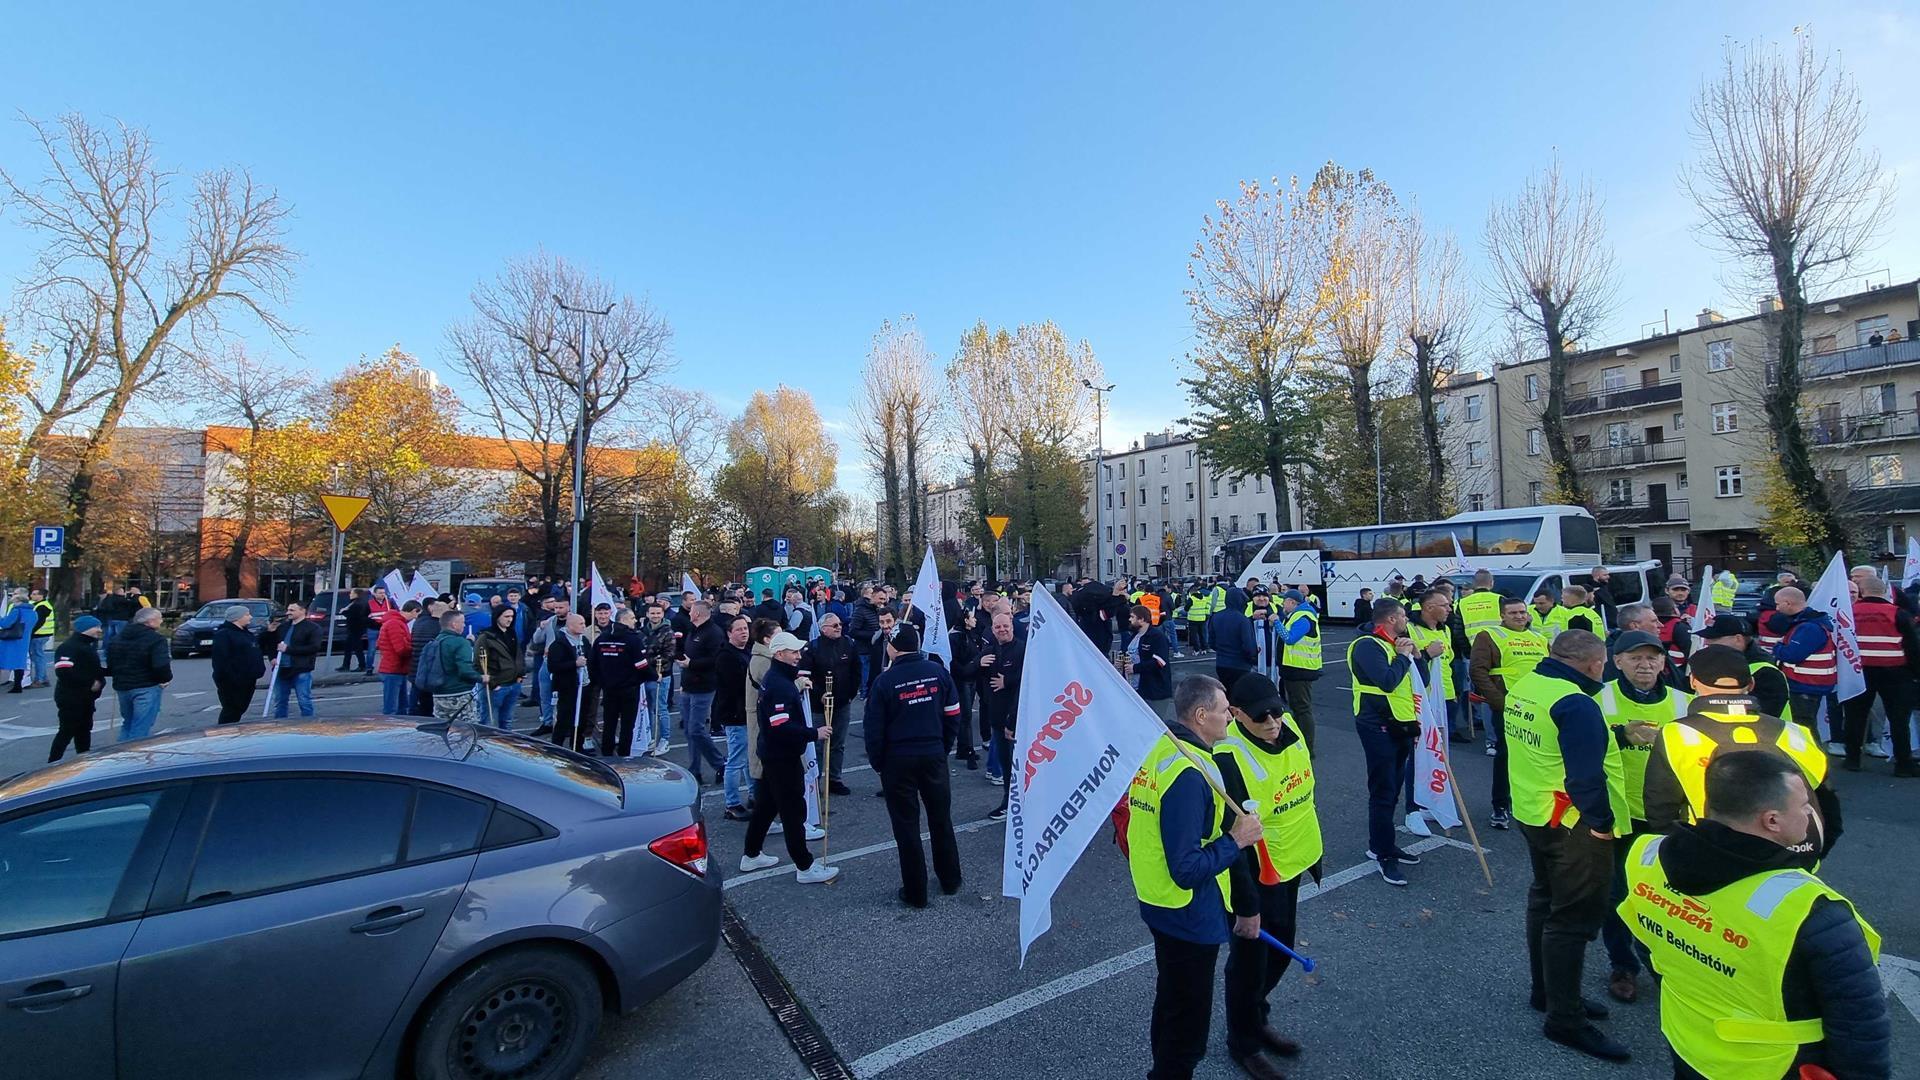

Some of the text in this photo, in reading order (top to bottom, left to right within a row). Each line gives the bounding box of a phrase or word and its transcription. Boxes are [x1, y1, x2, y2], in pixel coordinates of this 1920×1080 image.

[41, 529, 58, 547] P
[777, 539, 786, 552] P
[1523, 711, 1535, 722] 80
[1430, 768, 1448, 793] 80
[1633, 882, 1749, 949] Sierpień 80
[1637, 912, 1737, 979] KWB Bełchatów
